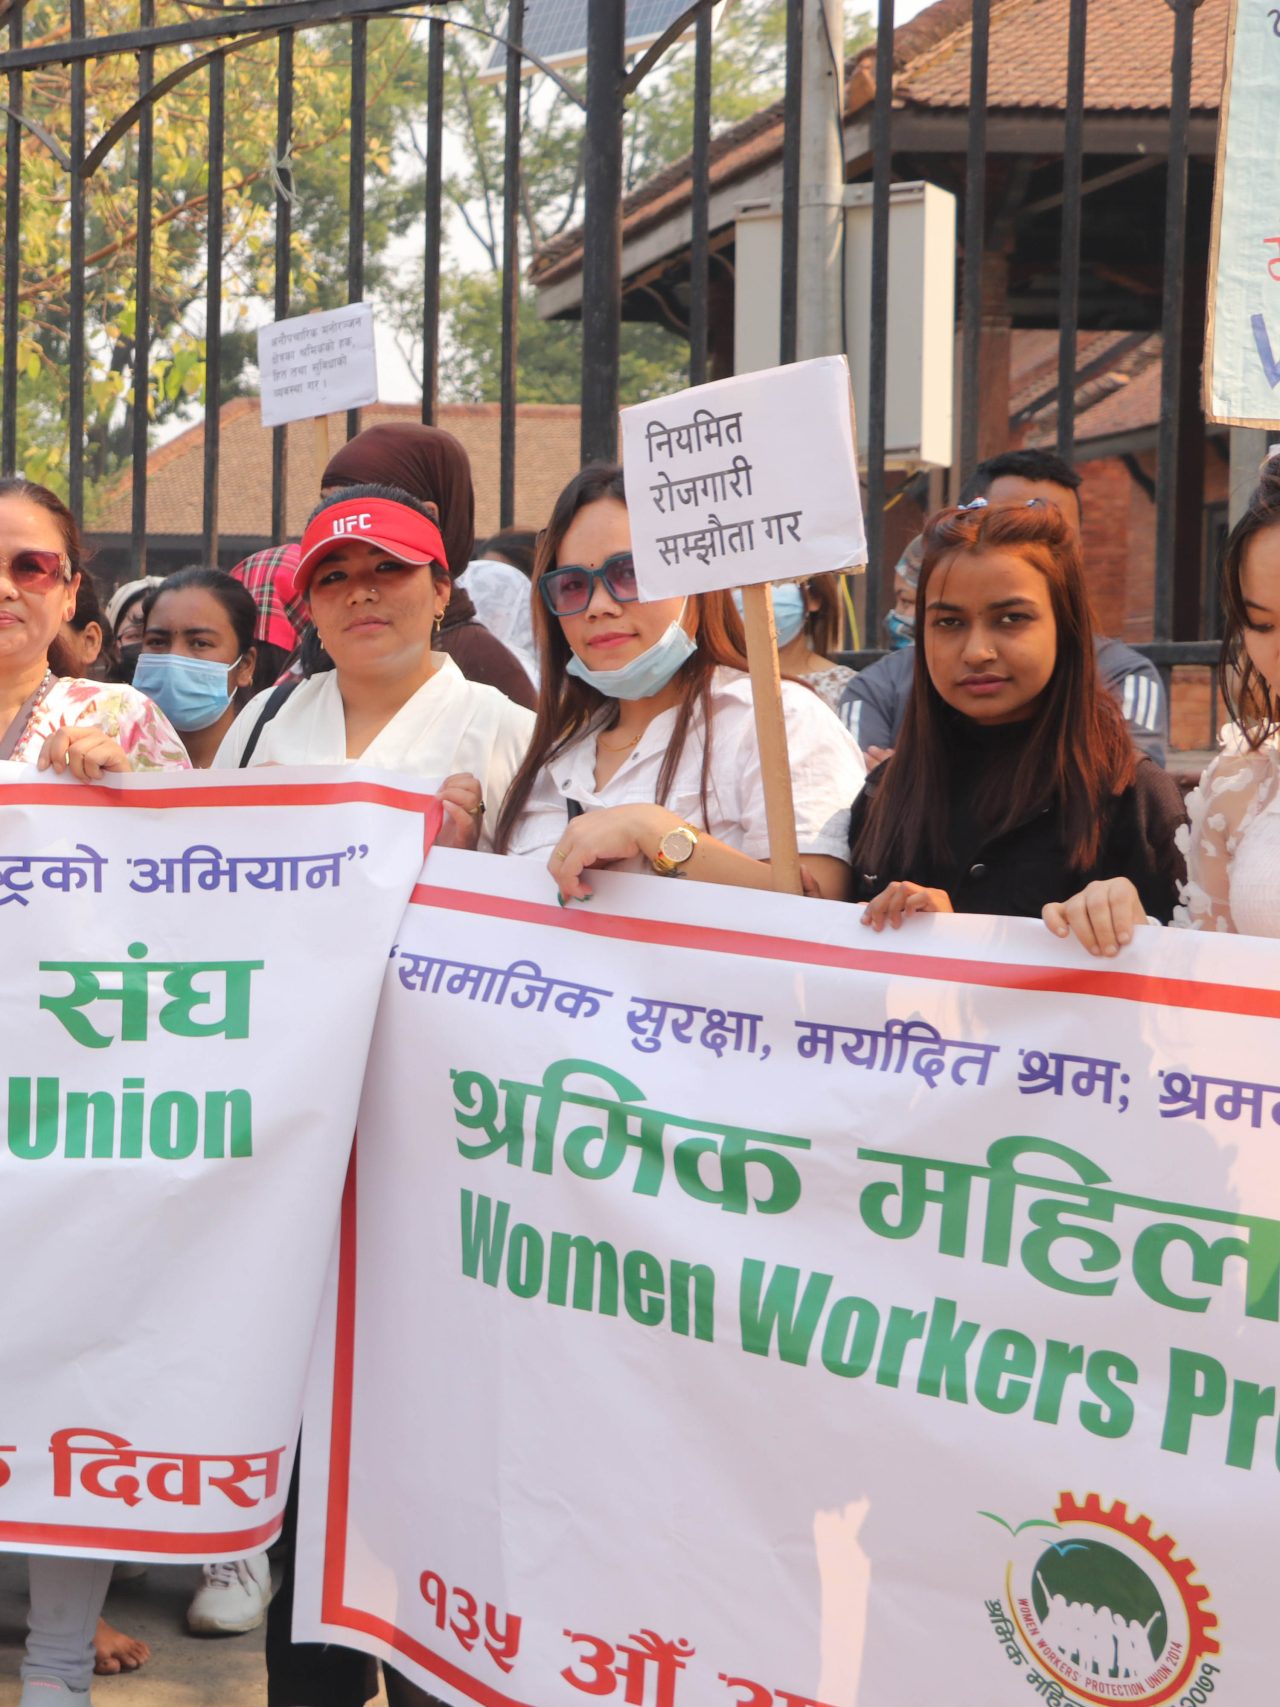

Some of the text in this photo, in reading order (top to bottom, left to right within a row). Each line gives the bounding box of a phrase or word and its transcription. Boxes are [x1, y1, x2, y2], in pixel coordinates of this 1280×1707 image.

[644, 409, 744, 463] नियमित
[332, 513, 372, 535] UFC
[649, 455, 753, 514] रोजगारी
[655, 510, 803, 566] सम्झौता गर
[126, 843, 369, 894] अभियान”
[39, 942, 264, 1050] संघ
[626, 997, 773, 1061] सुरक्षा,
[794, 1018, 1001, 1090] मर्यादित
[1017, 1049, 1131, 1114] श्रम;
[1158, 1069, 1280, 1129] श्रम
[7, 1076, 253, 1160] Union
[449, 1059, 1280, 1323] श्रमिक महिल
[460, 1189, 1280, 1471] Women Workers Pr
[48, 1427, 287, 1508] दिवस
[419, 1569, 523, 1674] १३५
[984, 1599, 1030, 1667] श्रमिक
[1017, 1598, 1040, 1636] WOMEN
[1085, 1677, 1146, 1699] PROTECTION
[1143, 1663, 1174, 1690] UNION
[1165, 1640, 1184, 1667] 2014
